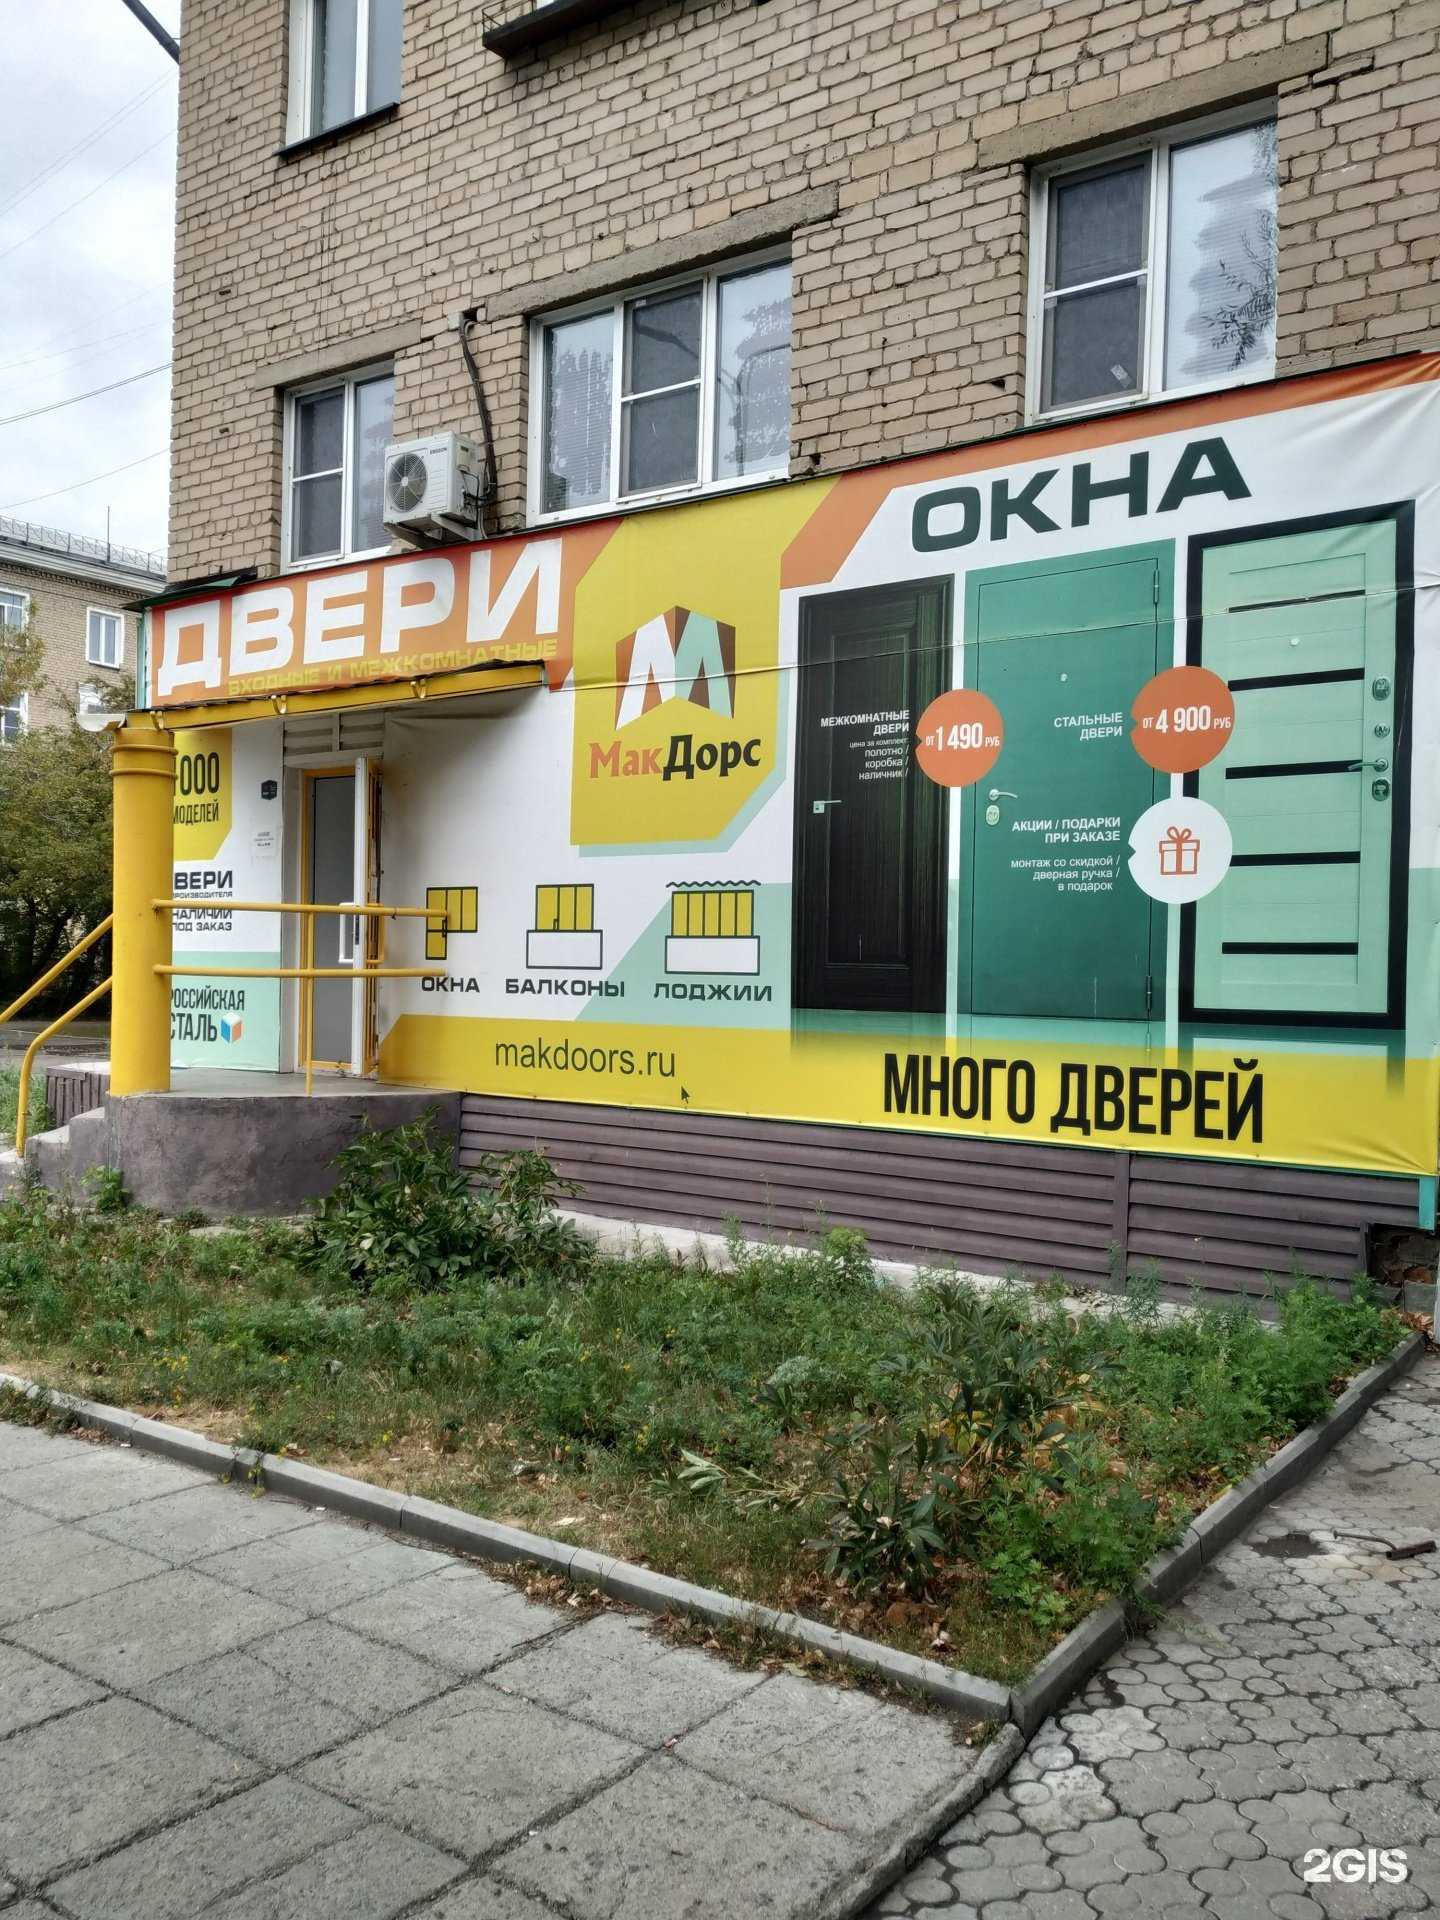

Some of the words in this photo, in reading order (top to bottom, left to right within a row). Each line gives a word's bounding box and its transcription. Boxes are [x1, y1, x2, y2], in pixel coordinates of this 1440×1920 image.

[911, 436, 1252, 553] ОКНА
[157, 538, 563, 697] ДВЕРИ
[228, 667, 320, 696] ВХОДНЫЕ
[327, 664, 342, 682] И
[350, 639, 557, 679] МЕЖКОМНАТНЫЕ
[820, 709, 910, 727] МЕЖКОМНАТНЫЕ
[1053, 712, 1123, 728] СТАЛЬНЫЕ
[1142, 717, 1154, 729] ОТ
[1213, 717, 1231, 729] РУБ
[873, 722, 910, 736] ДВЕРИ
[1080, 726, 1123, 741] ДВЕРИ
[925, 735, 935, 746] ОТ
[985, 736, 1000, 747] РУБ
[588, 734, 761, 781] МакДорс
[865, 747, 904, 758] полотно
[865, 757, 903, 770] коробка
[858, 770, 903, 780] наличник
[1012, 820, 1053, 832] АКЦИИ
[1062, 817, 1121, 830] ПОДАРКИ
[1045, 833, 1070, 843] ПРИ
[1073, 830, 1121, 842] ЗАКАЗЕ
[1011, 859, 1051, 868] монтаж
[1053, 859, 1067, 867] со
[1069, 856, 1113, 868] скидкой
[174, 870, 233, 890] ВЕРИ
[1033, 871, 1079, 881] дверная
[1082, 869, 1113, 880] ручка
[1058, 883, 1065, 891] в
[1067, 881, 1113, 892] подарок
[196, 922, 233, 932] ЗАКАЗ
[421, 976, 480, 993] ОКНА
[505, 978, 625, 997] БАЛКОНЫ
[653, 983, 772, 1002] ЛОДЖИИ
[495, 1037, 676, 1077] makdoors.ru
[884, 1052, 1035, 1124] МНОГО
[1050, 1057, 1263, 1143] ДВЕРЕЙ
